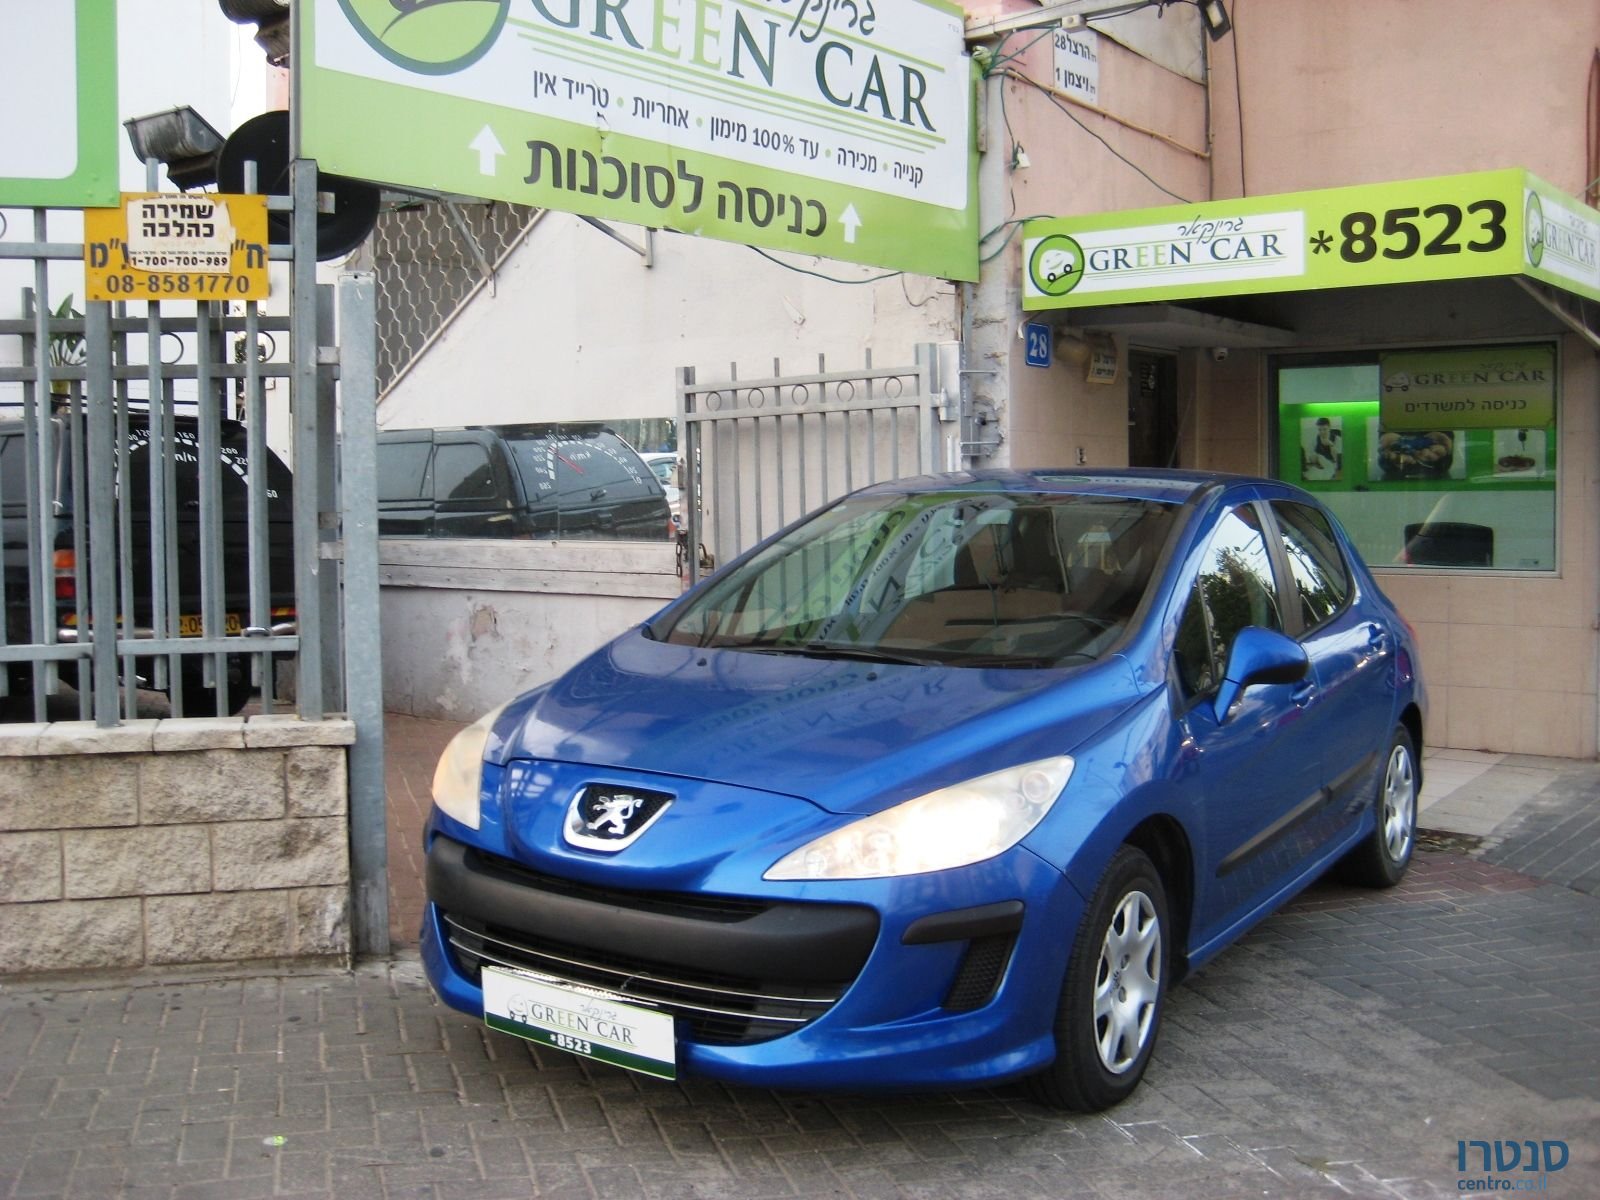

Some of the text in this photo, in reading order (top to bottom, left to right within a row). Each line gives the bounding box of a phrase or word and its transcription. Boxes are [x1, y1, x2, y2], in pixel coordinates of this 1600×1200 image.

[815, 41, 937, 132] CAR
[533, 70, 924, 189] קנייה מכירה עד 100% מימון אחריות טרייד אין
[523, 139, 827, 238] כניסה לסוכנות
[142, 203, 214, 219] שמירה
[143, 220, 215, 238] כהלכה
[131, 256, 228, 267] 1-700-700-989
[1089, 233, 1284, 272] GREEN CAR
[107, 274, 250, 294] 08-8581770
[1029, 332, 1048, 359] 28
[1415, 370, 1545, 386] GREEN CAR
[1404, 398, 1528, 413] כניסה למשרדים
[531, 1003, 635, 1045] GREEN CAR
